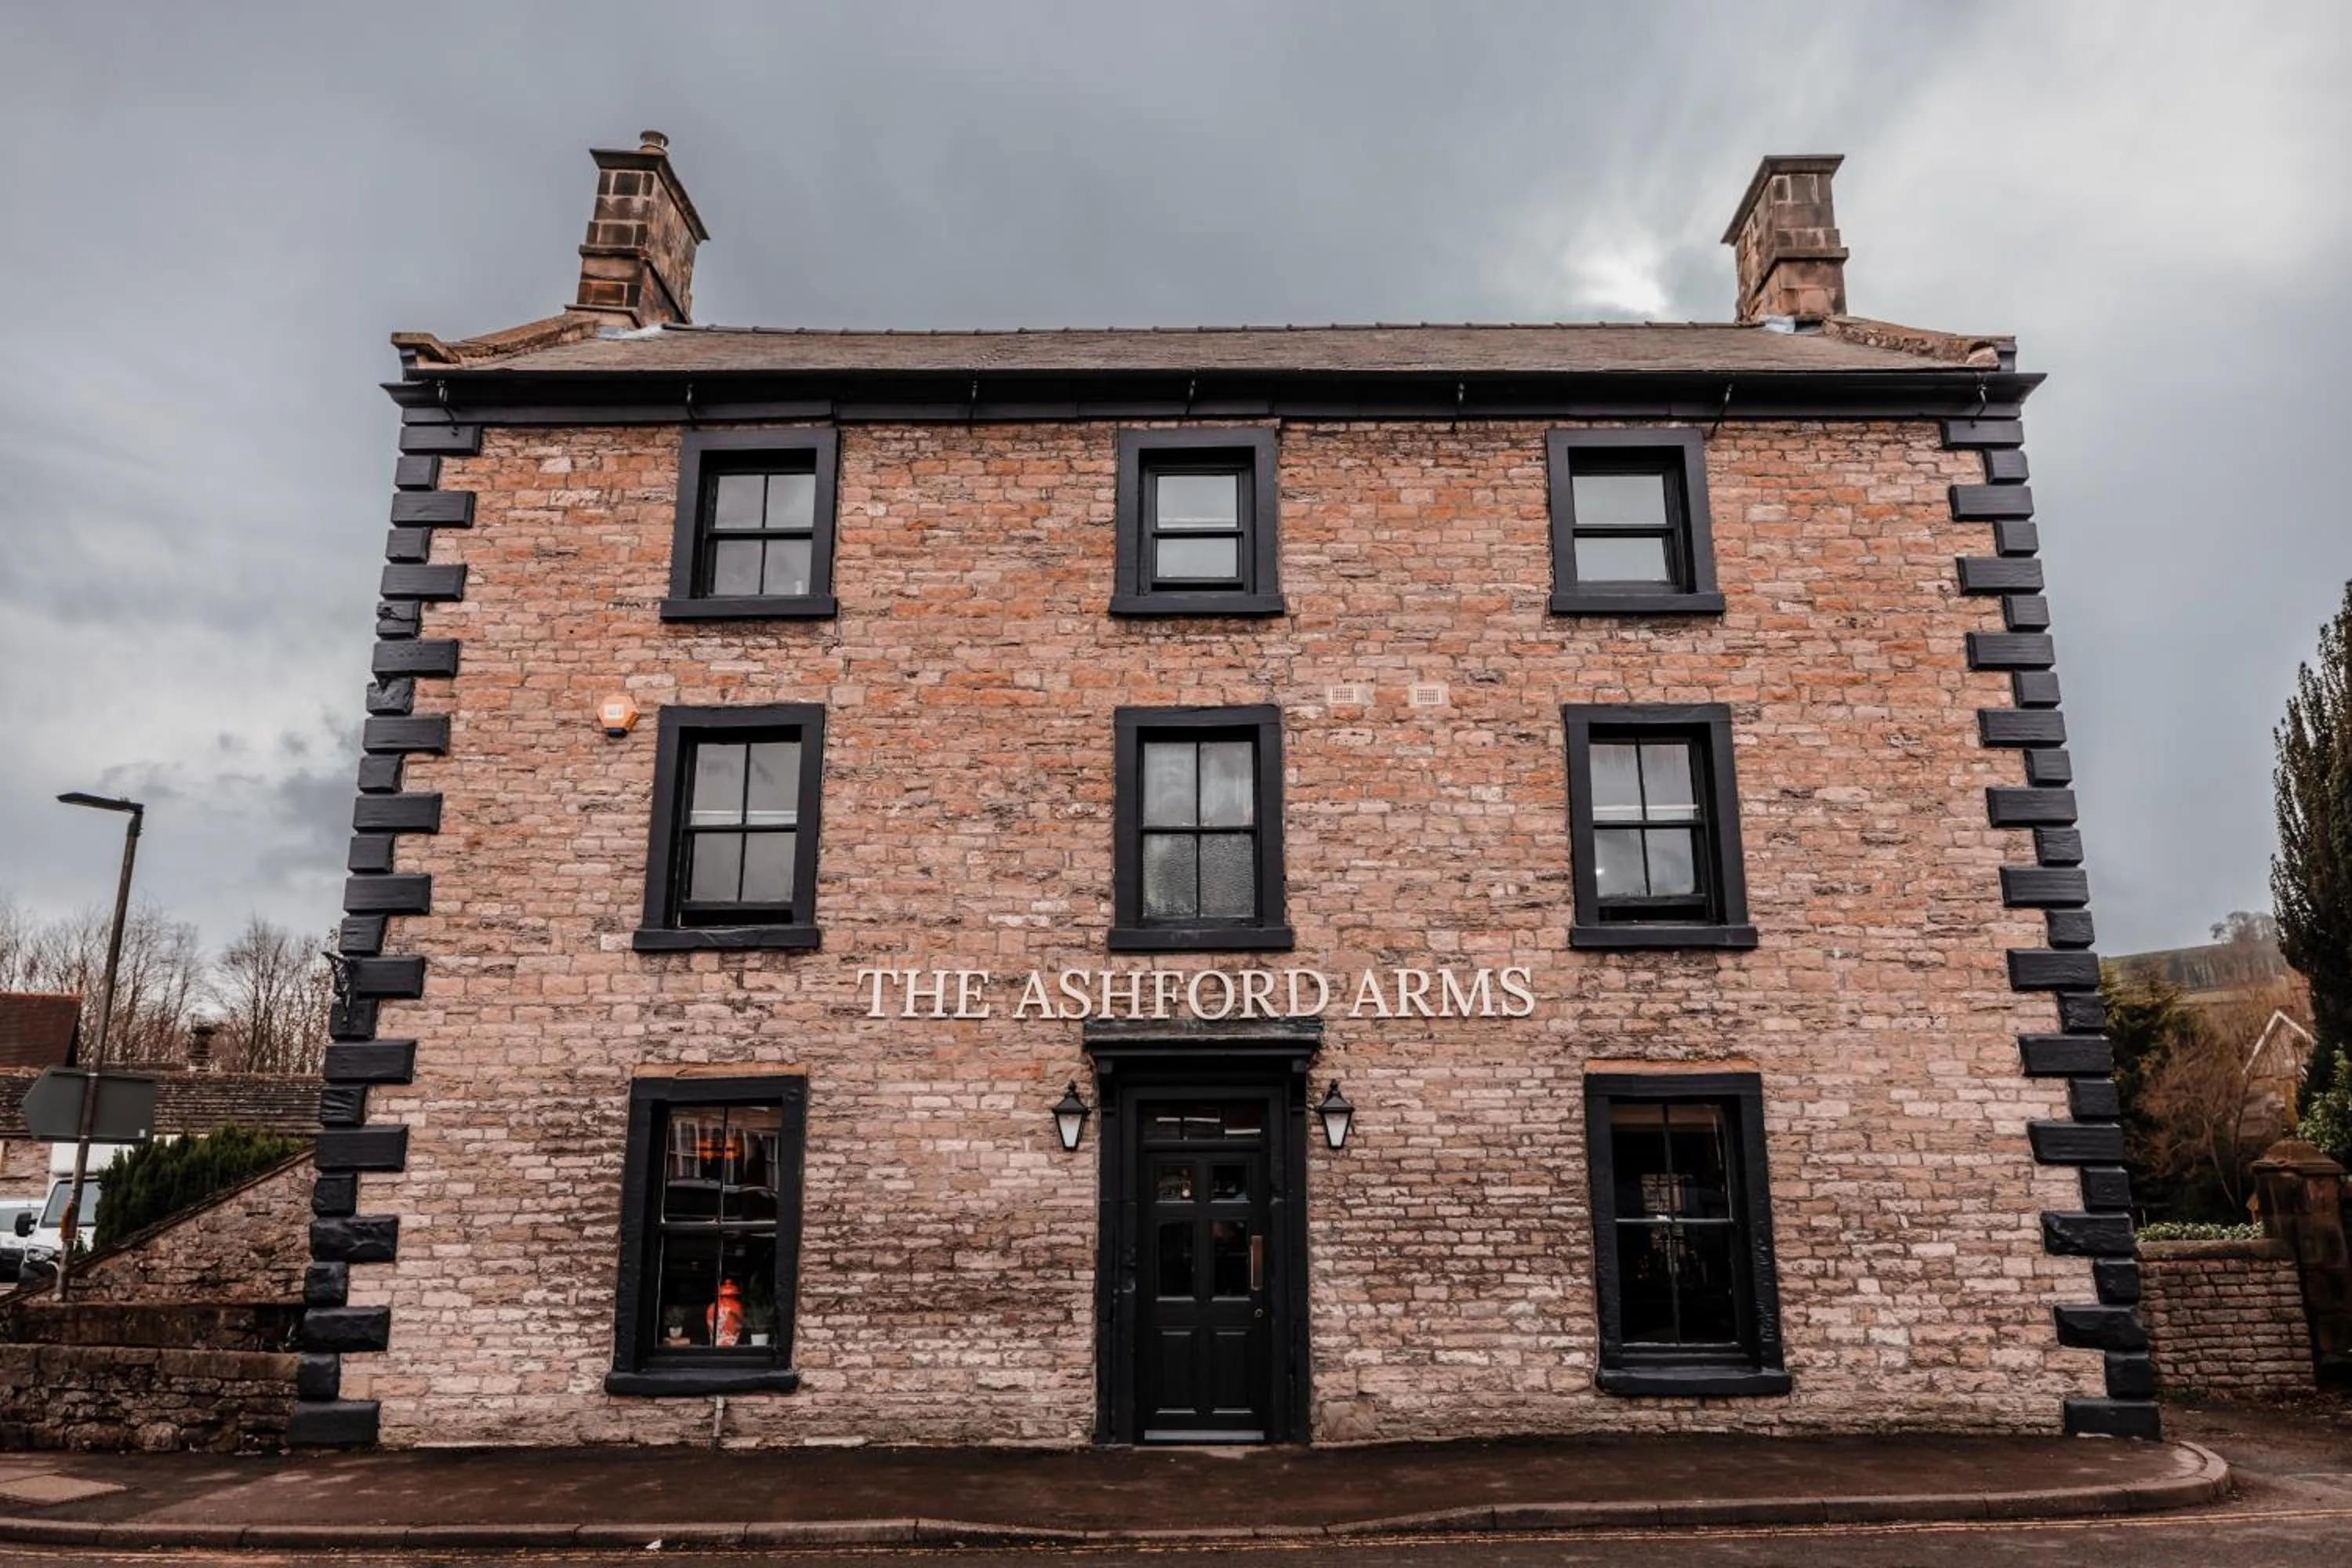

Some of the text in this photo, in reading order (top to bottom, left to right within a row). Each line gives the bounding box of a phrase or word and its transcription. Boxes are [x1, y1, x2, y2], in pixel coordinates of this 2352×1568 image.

[857, 967, 1535, 1019] THE ASHFORD ARMS
